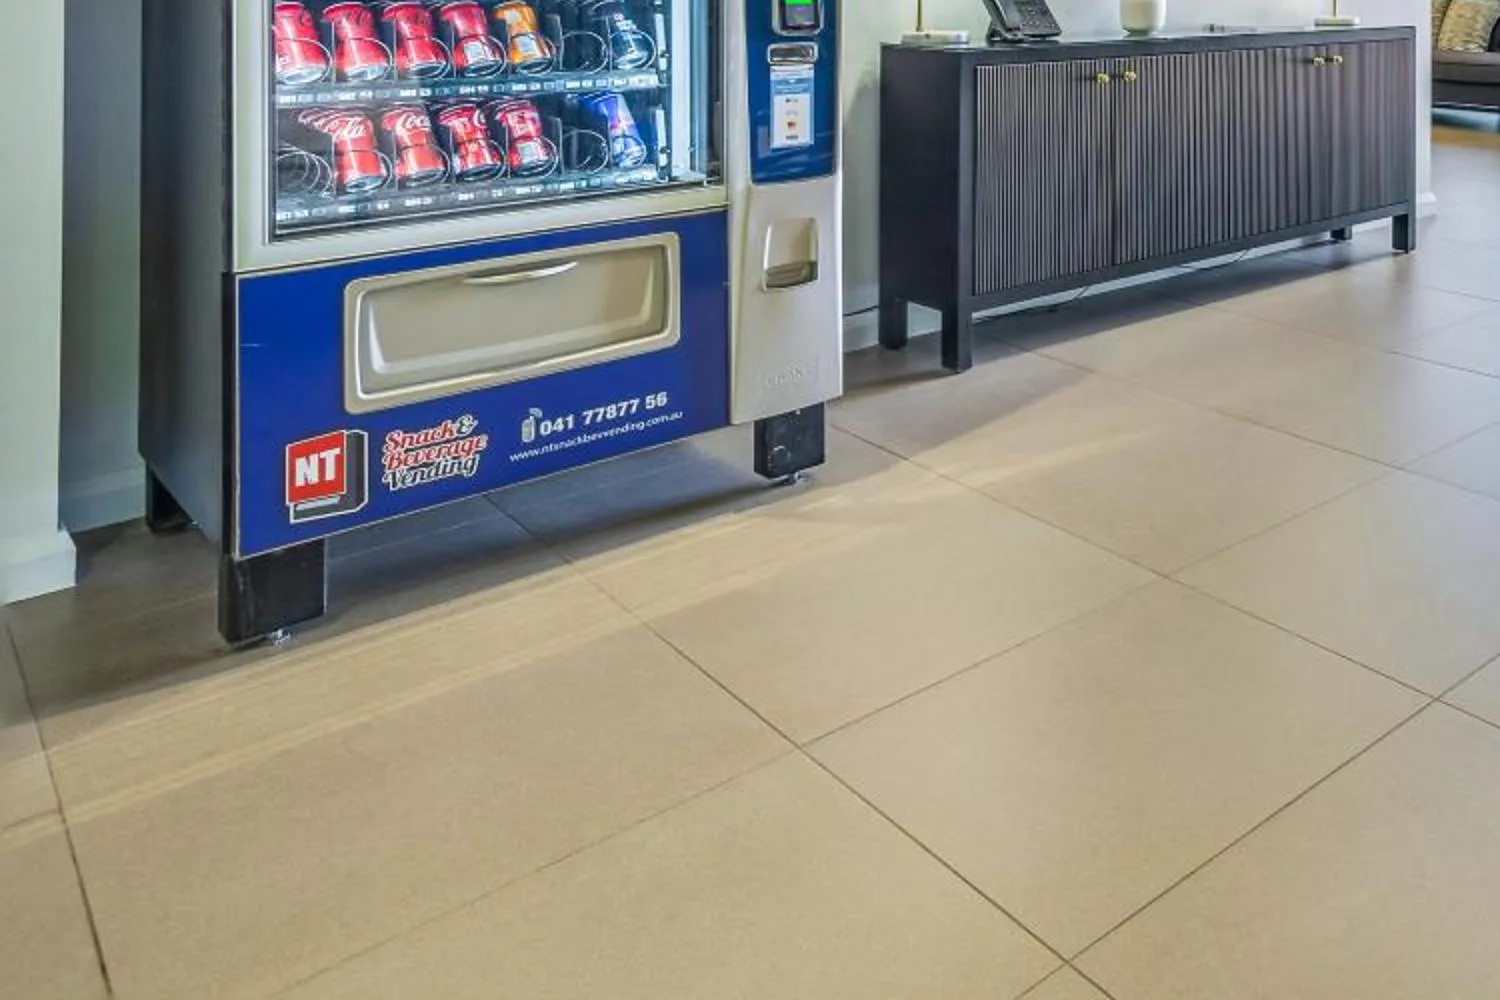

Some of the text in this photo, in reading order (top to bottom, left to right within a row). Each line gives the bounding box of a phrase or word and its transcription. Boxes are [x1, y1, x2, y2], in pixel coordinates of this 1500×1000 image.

[539, 391, 669, 436] 041 77877 56
[295, 447, 341, 487] NT
[382, 434, 489, 472] Beverage
[382, 455, 480, 492] Vending
